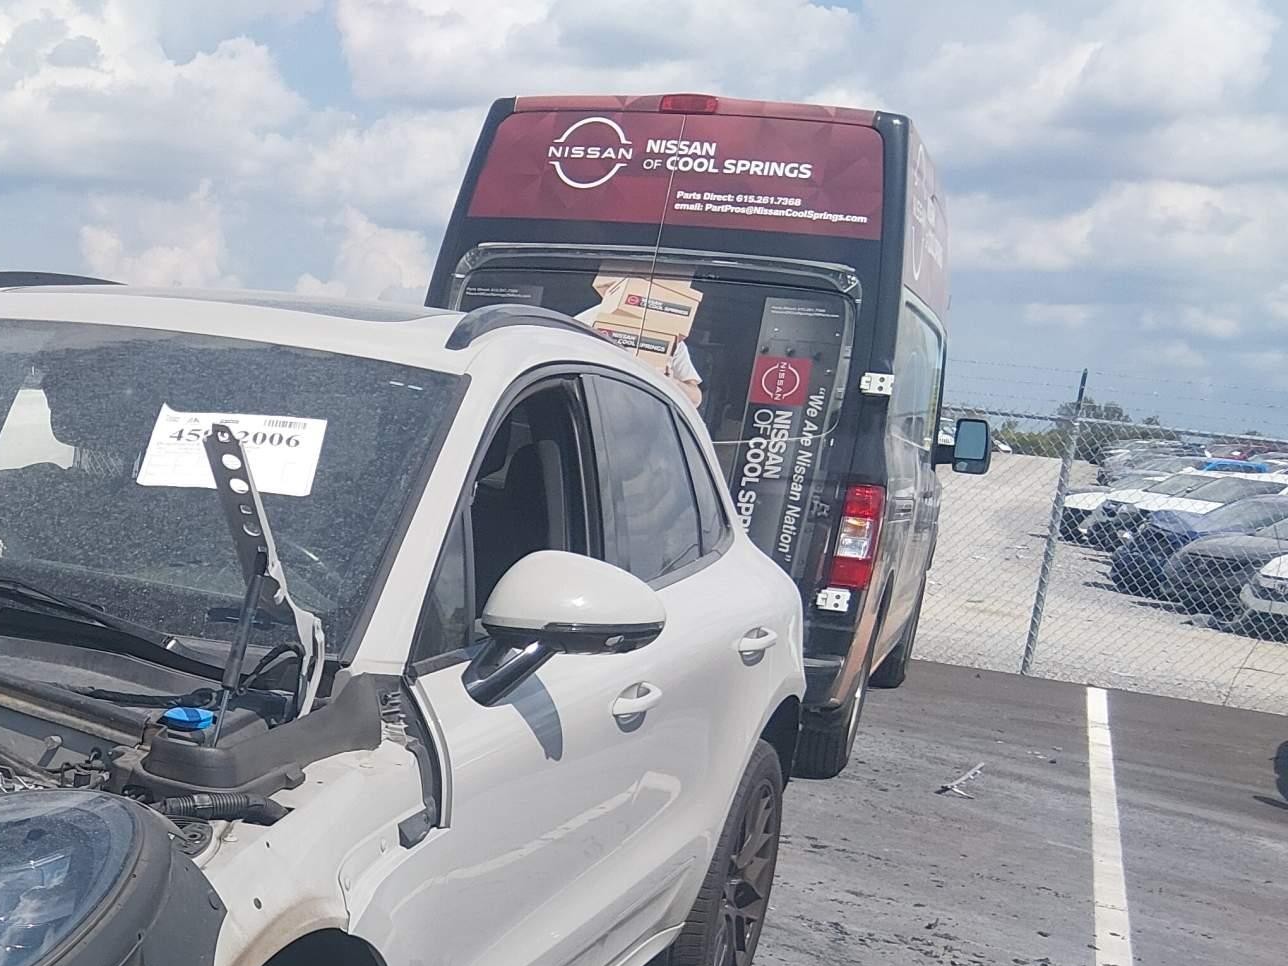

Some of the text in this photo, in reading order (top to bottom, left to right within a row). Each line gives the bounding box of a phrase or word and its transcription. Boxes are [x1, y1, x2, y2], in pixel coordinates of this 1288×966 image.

[548, 145, 633, 160] NISSAN
[646, 139, 717, 156] NISSAN
[642, 157, 813, 179] OF COOL SPRINGS
[676, 190, 701, 200] Parts
[703, 192, 734, 202] Direct:
[674, 202, 868, 223] email: PartPros@NissanCoolSprings.com
[773, 361, 788, 401] NISSAN
[753, 408, 774, 435] OF
[800, 419, 818, 446] Are
[763, 410, 793, 479] NISSAN
[740, 436, 767, 487] COOL
[789, 450, 813, 501] Nissan
